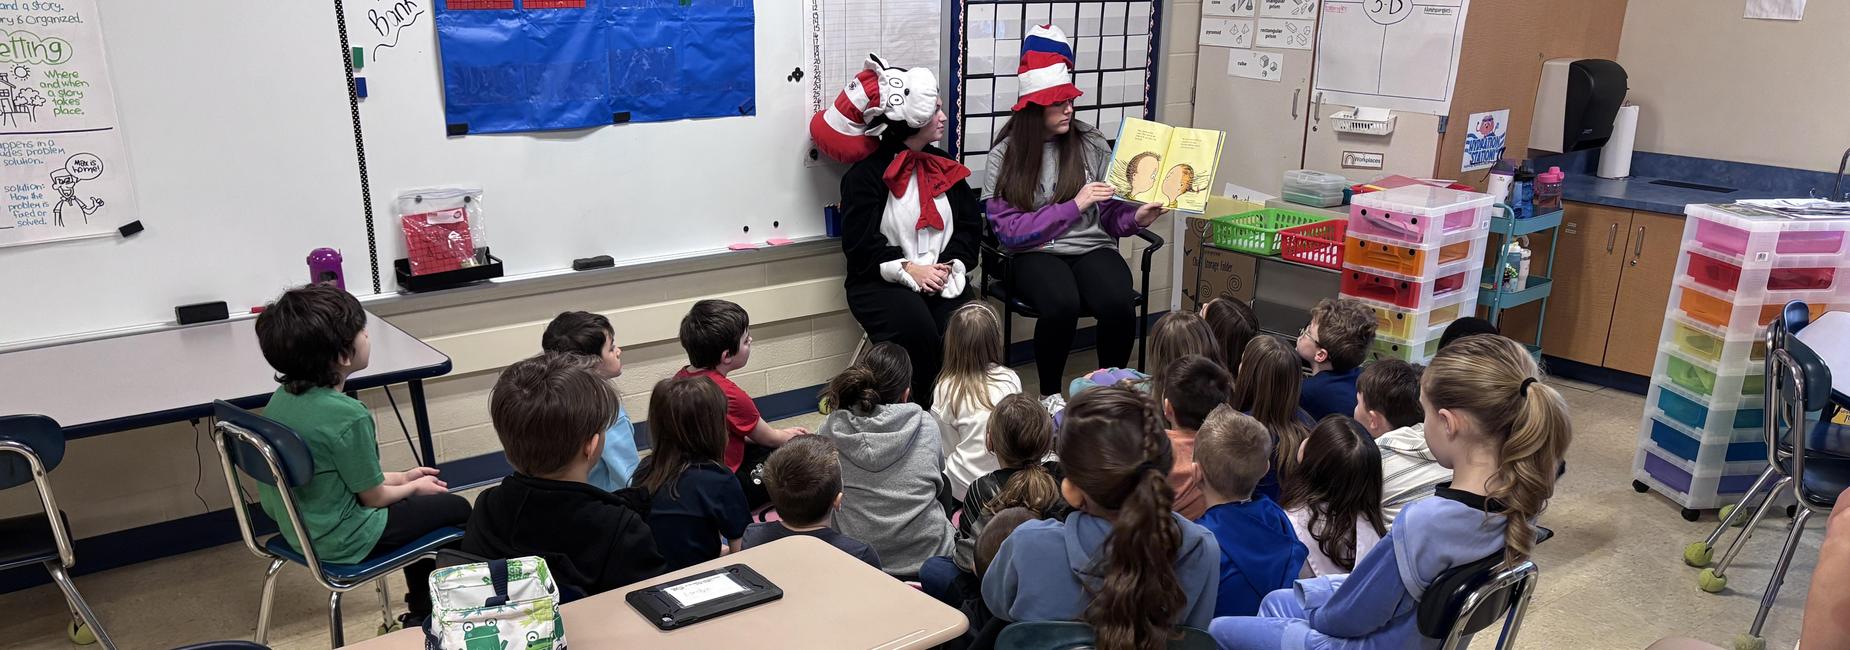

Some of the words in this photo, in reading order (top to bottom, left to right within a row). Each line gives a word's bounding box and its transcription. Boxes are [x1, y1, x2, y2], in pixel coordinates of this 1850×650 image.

[0, 0, 18, 10] and
[22, 3, 29, 11] a
[31, 1, 64, 12] story.
[0, 17, 15, 26] ry
[44, 70, 79, 79] Where
[40, 80, 60, 88] and
[61, 78, 90, 88] when
[58, 88, 84, 98] story
[52, 97, 80, 106] takes
[53, 106, 85, 117] place.
[26, 147, 65, 157] problem
[4, 158, 44, 166] solution.
[72, 165, 100, 173] home!
[31, 192, 43, 200] the
[8, 201, 41, 211] problem
[13, 210, 36, 218] fixed
[17, 218, 47, 227] solved.
